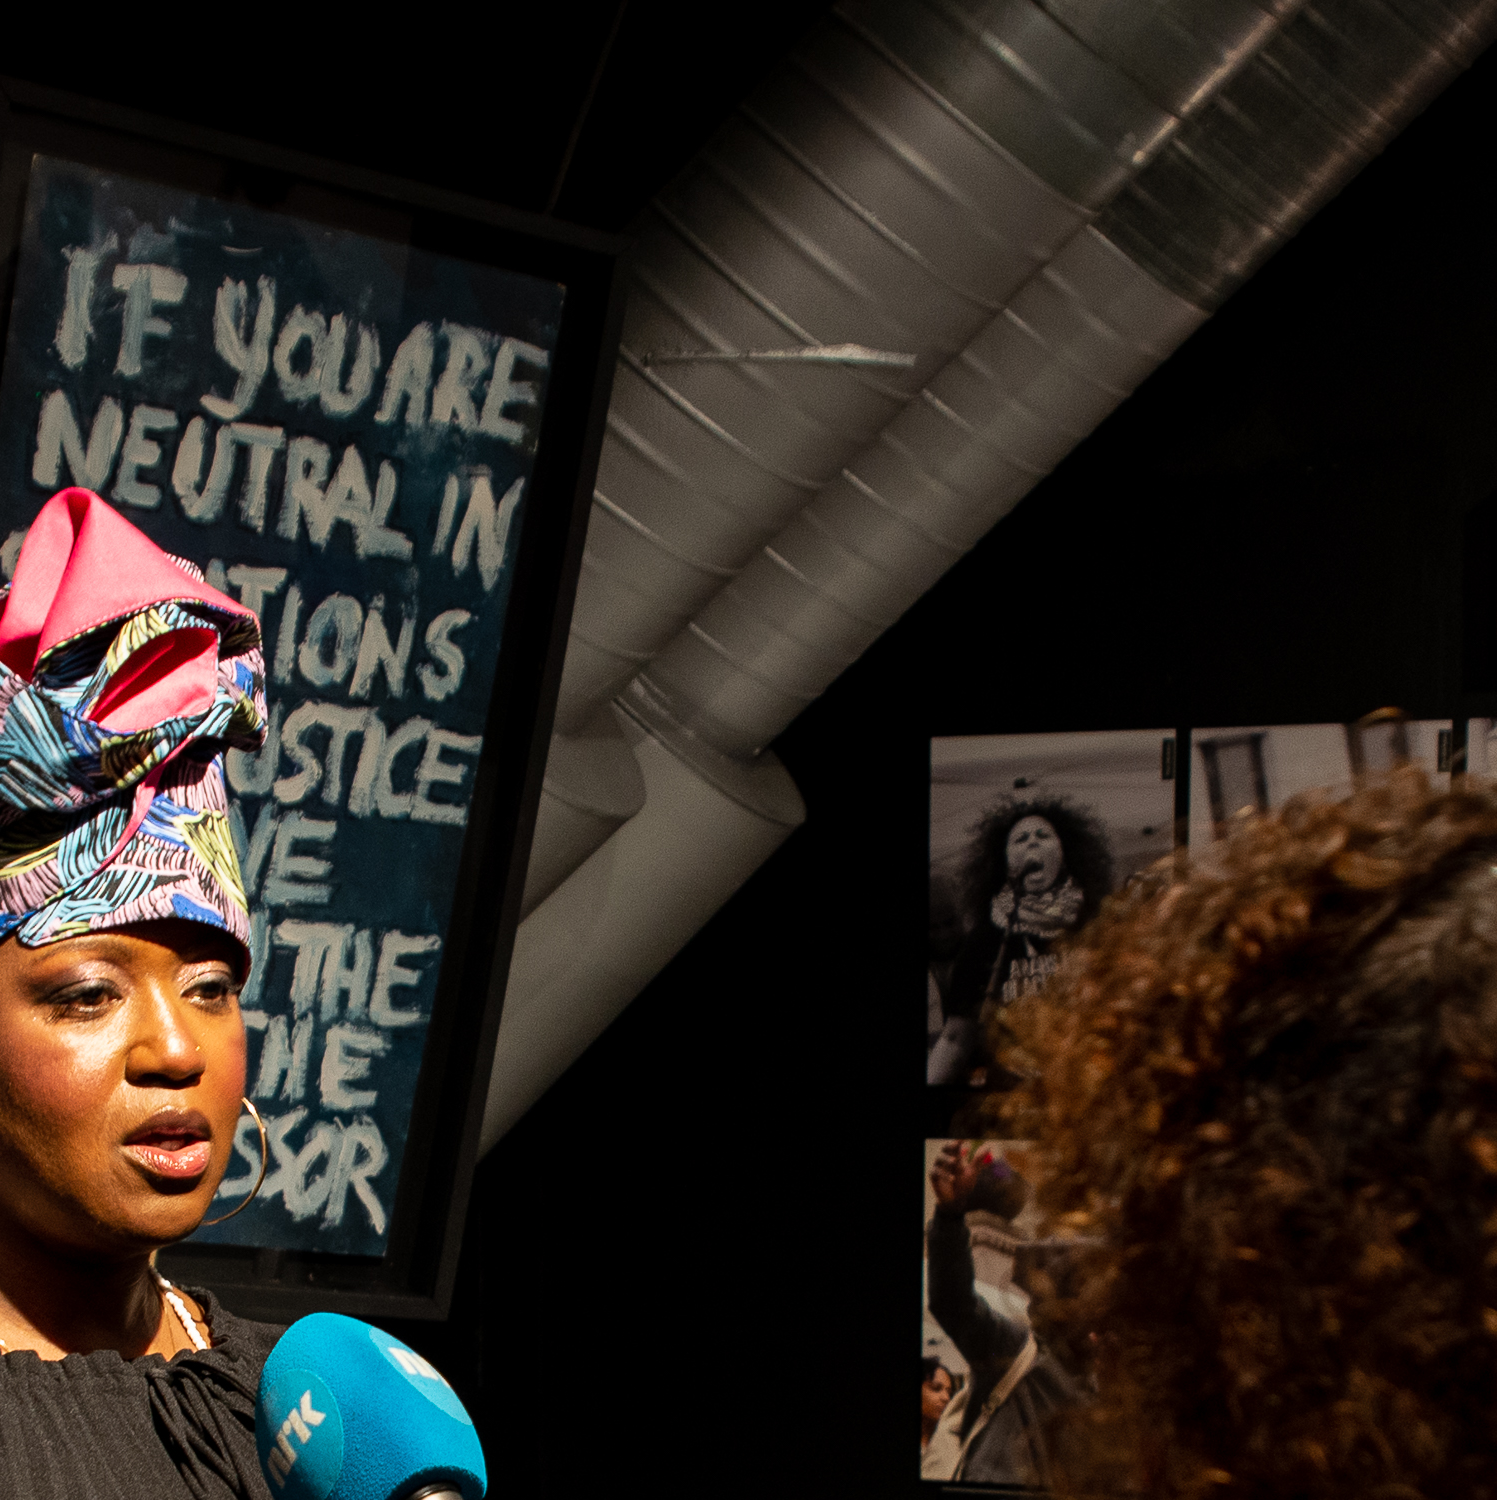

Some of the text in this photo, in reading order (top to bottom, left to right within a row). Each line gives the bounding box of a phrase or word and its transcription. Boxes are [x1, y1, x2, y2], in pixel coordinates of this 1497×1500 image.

[55, 243, 549, 442] IF YOU ARE
[32, 389, 526, 590] NEUTRAL IN
[274, 919, 441, 1027] THE
